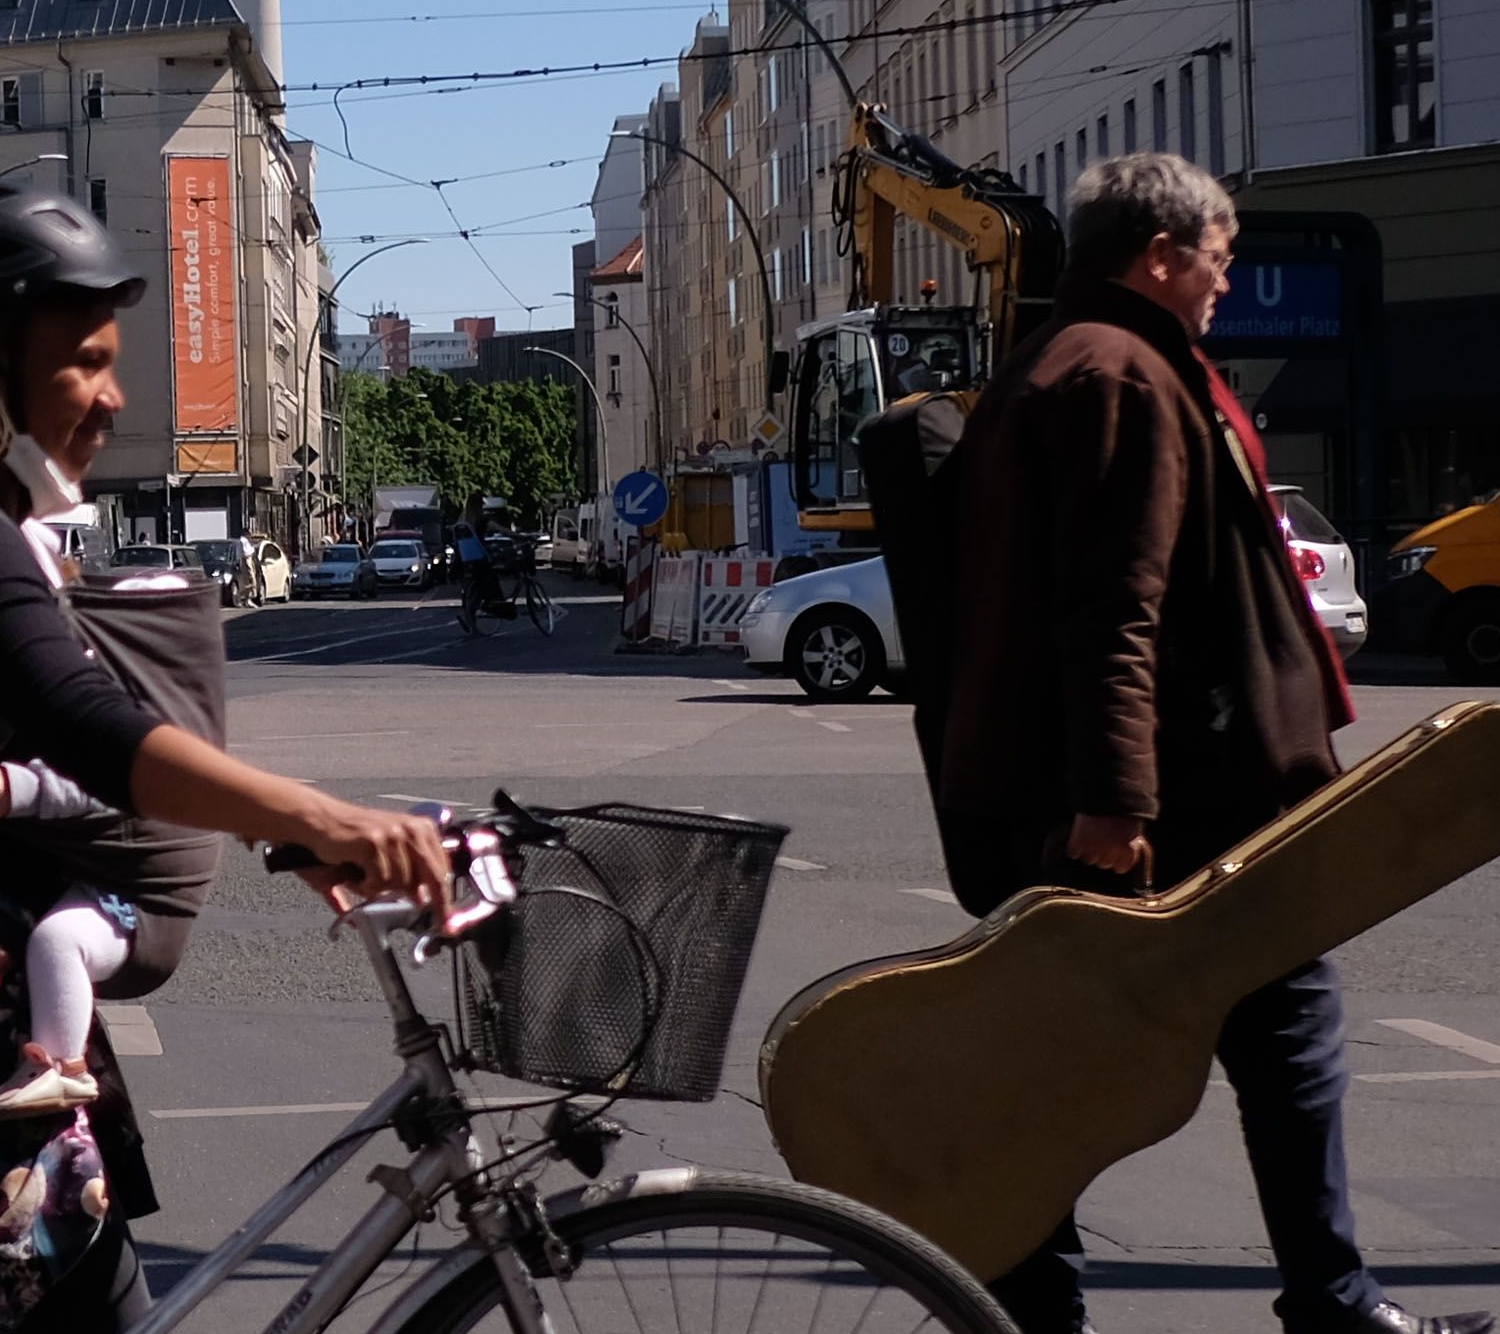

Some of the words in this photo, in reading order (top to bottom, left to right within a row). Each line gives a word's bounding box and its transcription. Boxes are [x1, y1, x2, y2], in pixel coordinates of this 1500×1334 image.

[207, 220, 221, 256] great
[181, 176, 205, 364] easyHotel.com
[205, 260, 220, 315] comfort,
[1255, 265, 1283, 307] U
[208, 318, 221, 364] Simple
[892, 336, 907, 352] 20
[1209, 317, 1295, 337] osenthaler
[1300, 317, 1342, 337] Platz
